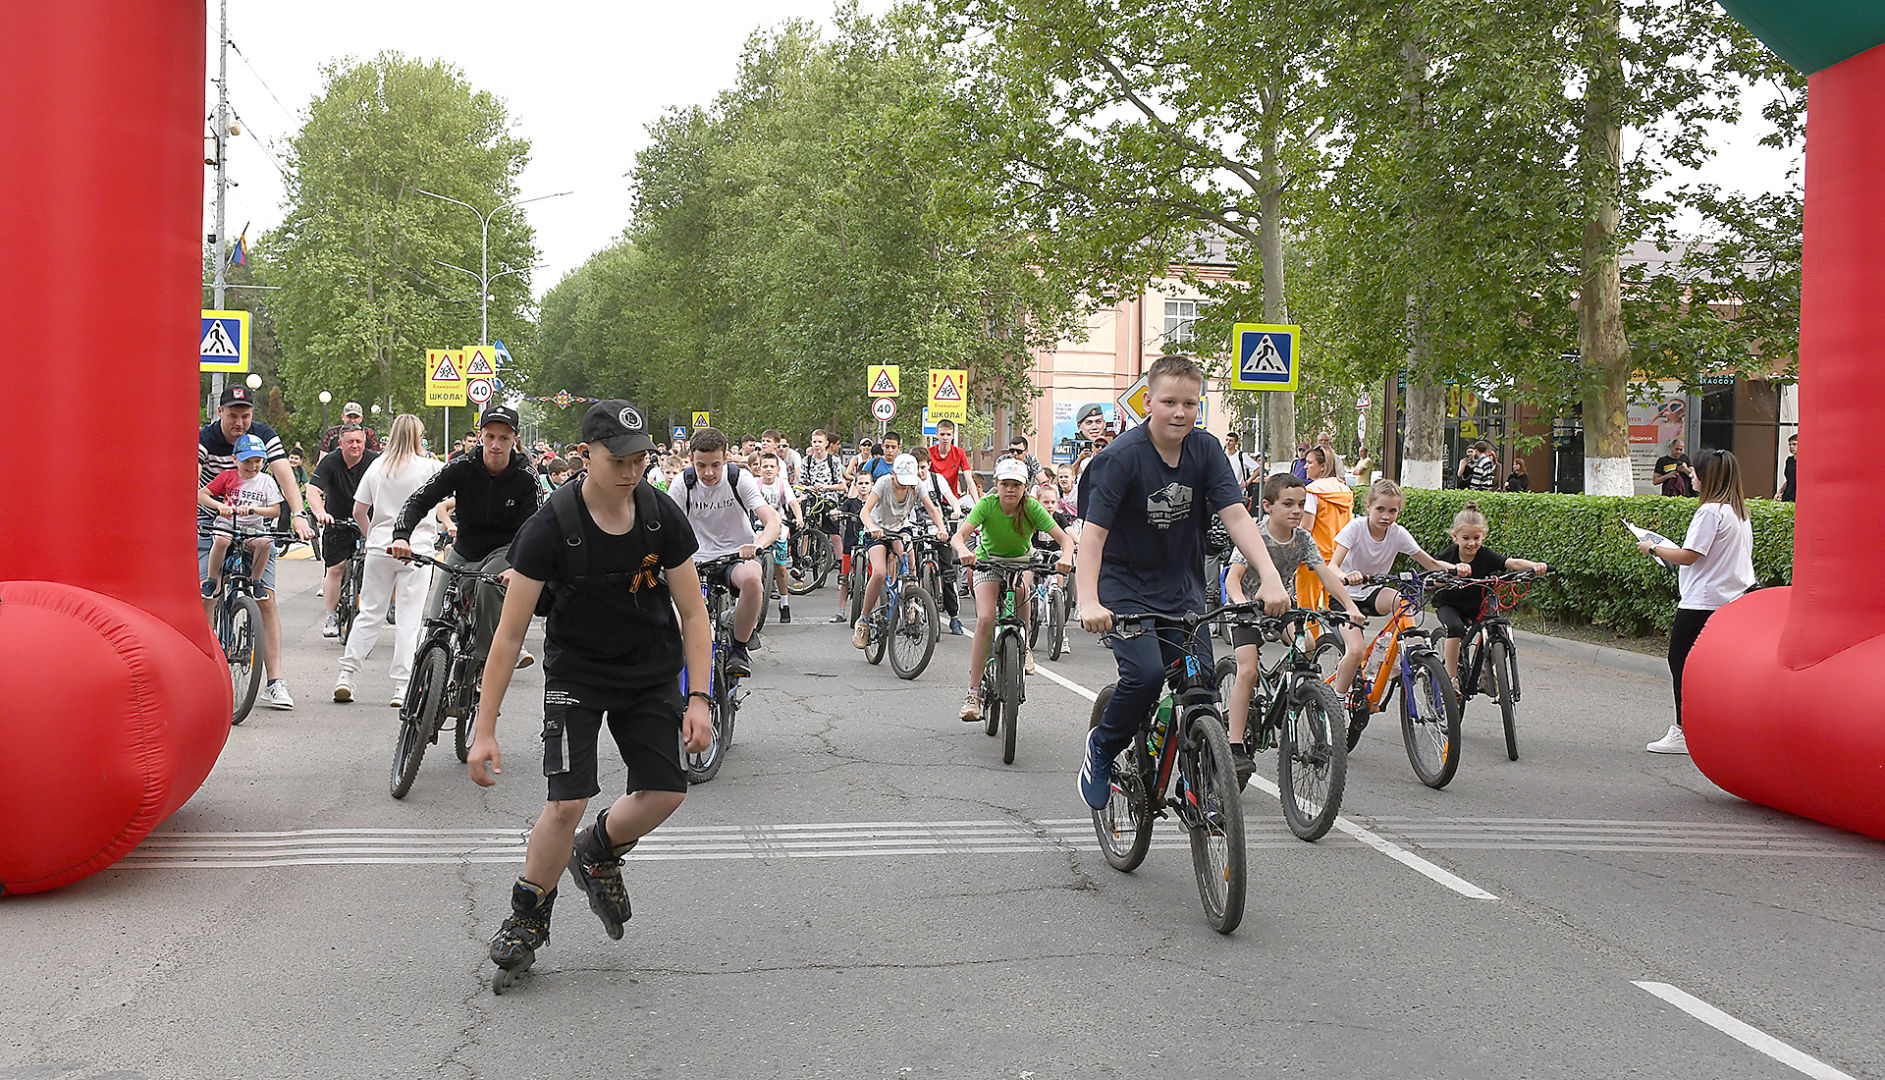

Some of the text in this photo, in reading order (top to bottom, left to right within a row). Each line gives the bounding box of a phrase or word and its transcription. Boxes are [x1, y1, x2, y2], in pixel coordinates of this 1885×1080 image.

[472, 386, 488, 396] 40
[876, 404, 891, 413] 40
[931, 411, 963, 419] ШКОЛА!
